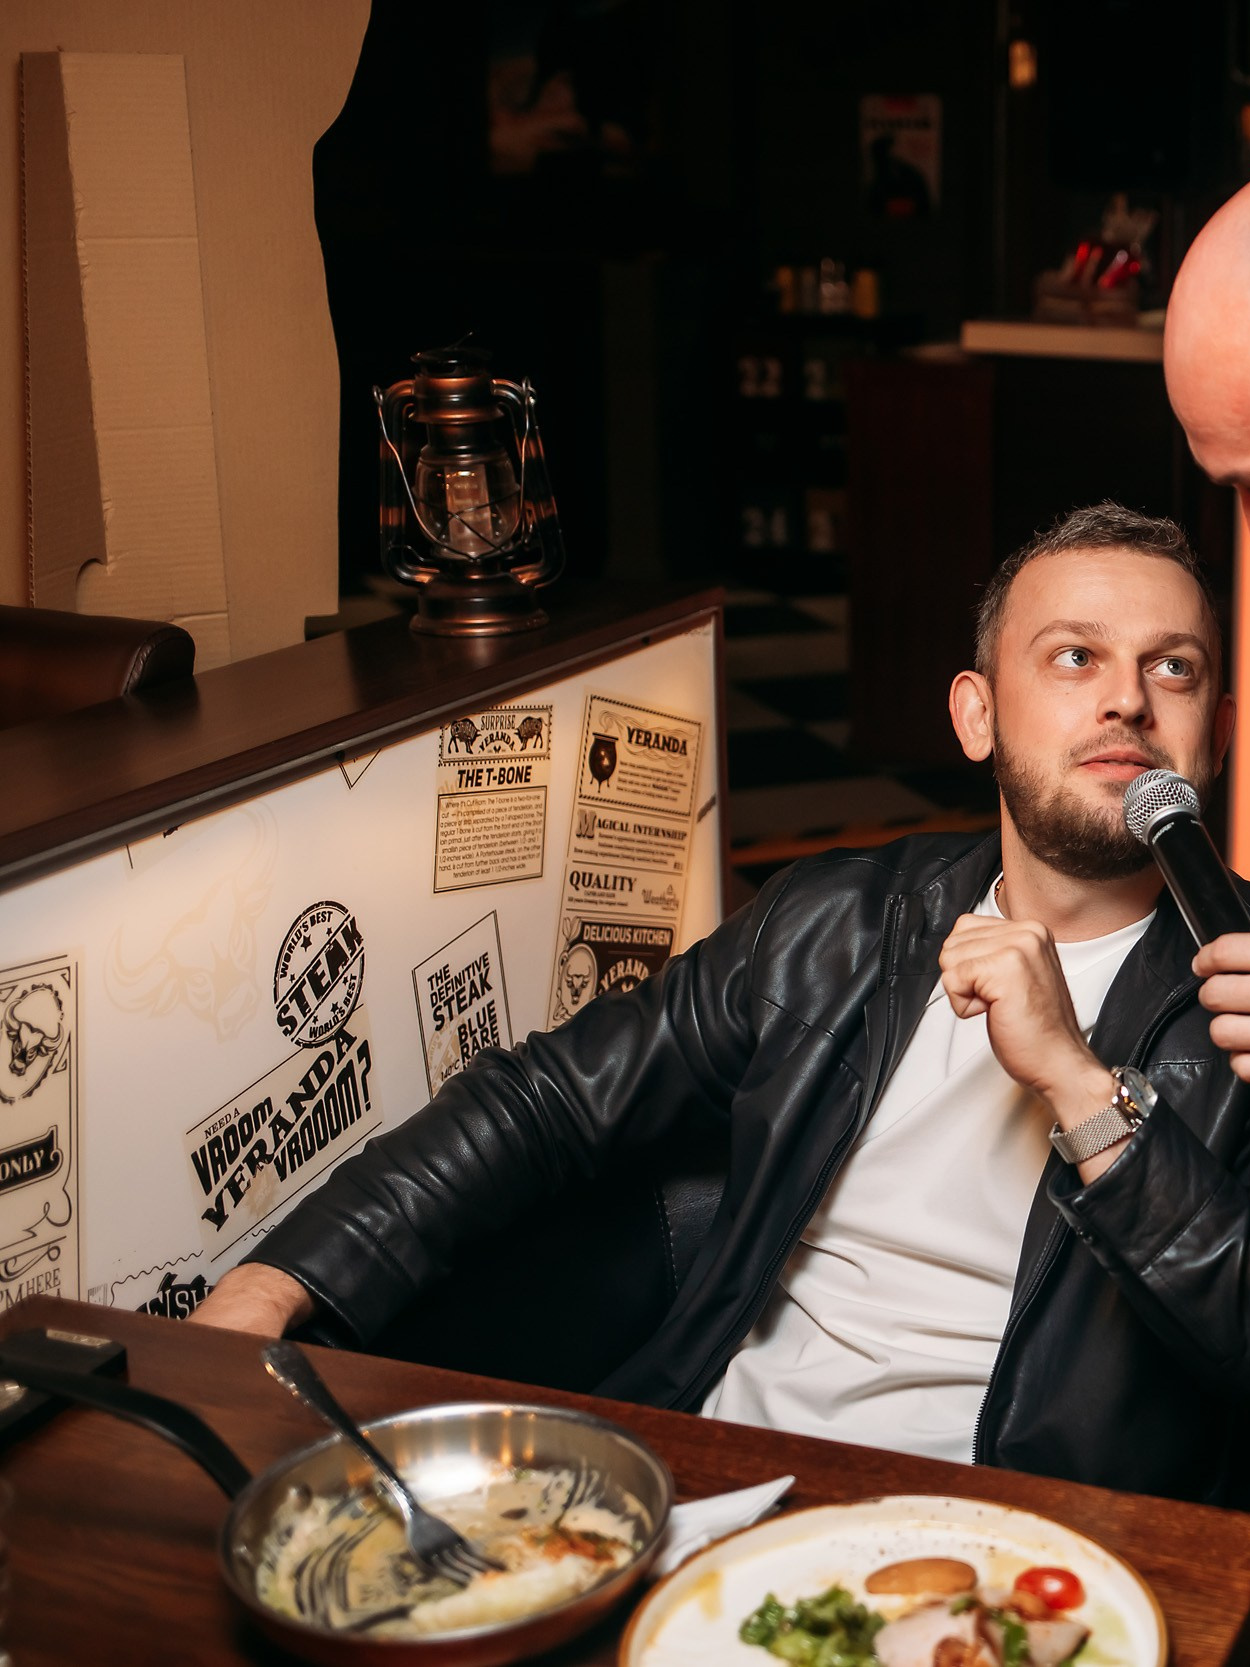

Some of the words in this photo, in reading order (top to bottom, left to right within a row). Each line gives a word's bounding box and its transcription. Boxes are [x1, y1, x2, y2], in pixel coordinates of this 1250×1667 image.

[480, 714, 516, 731] SURPRISE
[479, 731, 516, 752] VERANDA
[626, 726, 688, 756] VERANDA
[457, 768, 484, 789] THE
[486, 765, 532, 786] T-BONE
[633, 823, 687, 841] INTERNSHIP
[569, 870, 637, 893] QUALITY
[279, 921, 310, 979] WORLD'S
[309, 910, 334, 928] BEST
[583, 925, 631, 942] DELICIOUS
[632, 928, 671, 946] KITCHEN
[276, 916, 364, 1037] STEAK
[427, 963, 451, 991] THE
[429, 952, 490, 1009] DEFINITIVE
[600, 958, 650, 992] VERAND
[309, 1006, 345, 1038] WORLD'S
[345, 973, 357, 1008] BEST
[432, 966, 493, 1032] STEAK
[457, 999, 498, 1045] BLUE
[460, 1019, 499, 1065] RARE
[201, 1027, 358, 1232] VERANDA
[204, 1113, 231, 1140] NEED
[233, 1107, 241, 1119] A
[0, 1149, 45, 1182] ONLY
[26, 1267, 61, 1296] HERE
